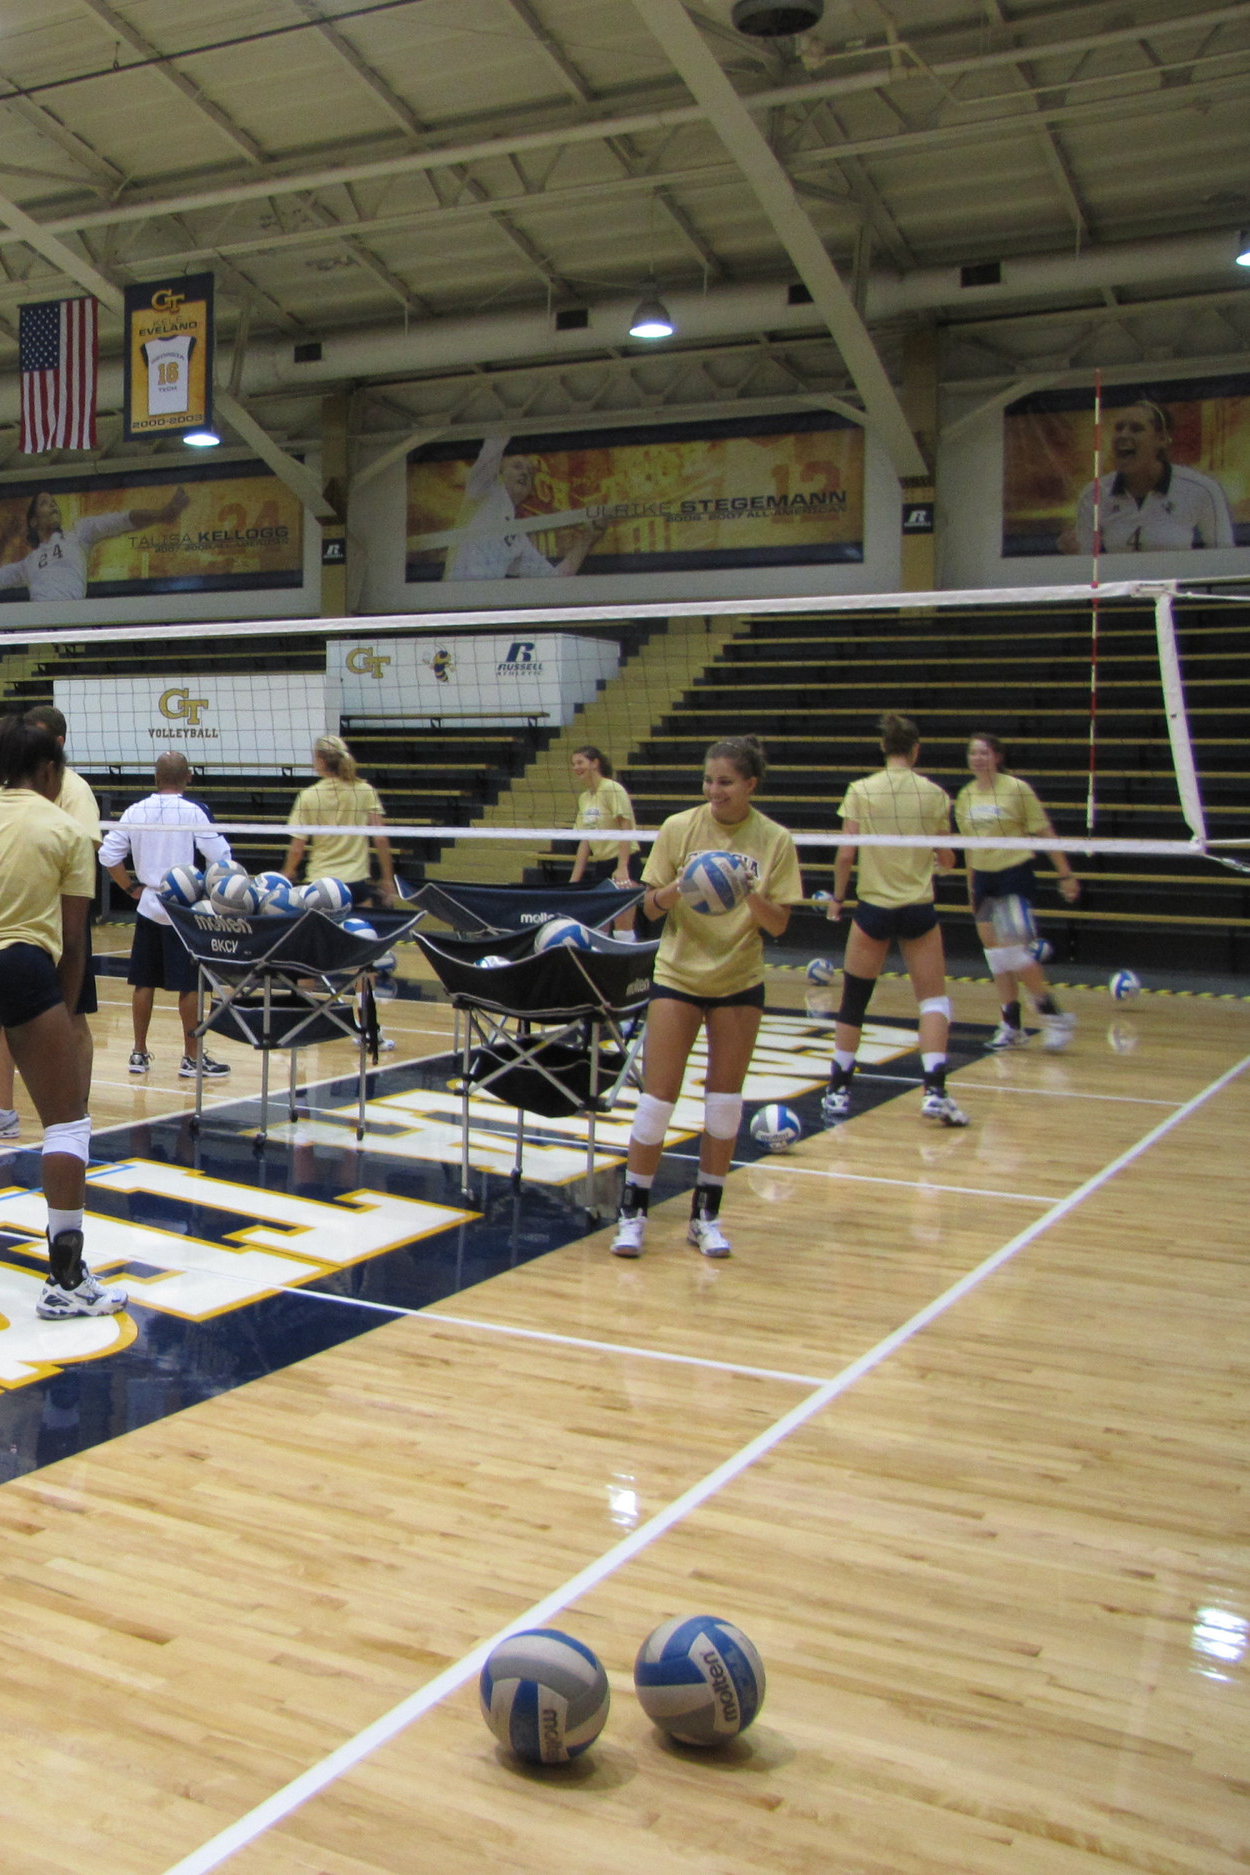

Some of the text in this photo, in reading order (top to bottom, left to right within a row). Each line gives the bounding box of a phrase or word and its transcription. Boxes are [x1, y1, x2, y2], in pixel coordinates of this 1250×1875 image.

[151, 289, 185, 313] GT
[139, 321, 198, 336] EVELAND
[158, 362, 179, 385] 16
[680, 491, 847, 513] STEGEMANN
[129, 527, 288, 548] TALISA KELLOGG
[346, 647, 391, 679] GT
[497, 663, 543, 671] RUSSELL
[158, 687, 209, 725] GT
[148, 728, 219, 738] VOLLEYBALL
[193, 914, 253, 935] molten
[703, 1650, 738, 1723] molten
